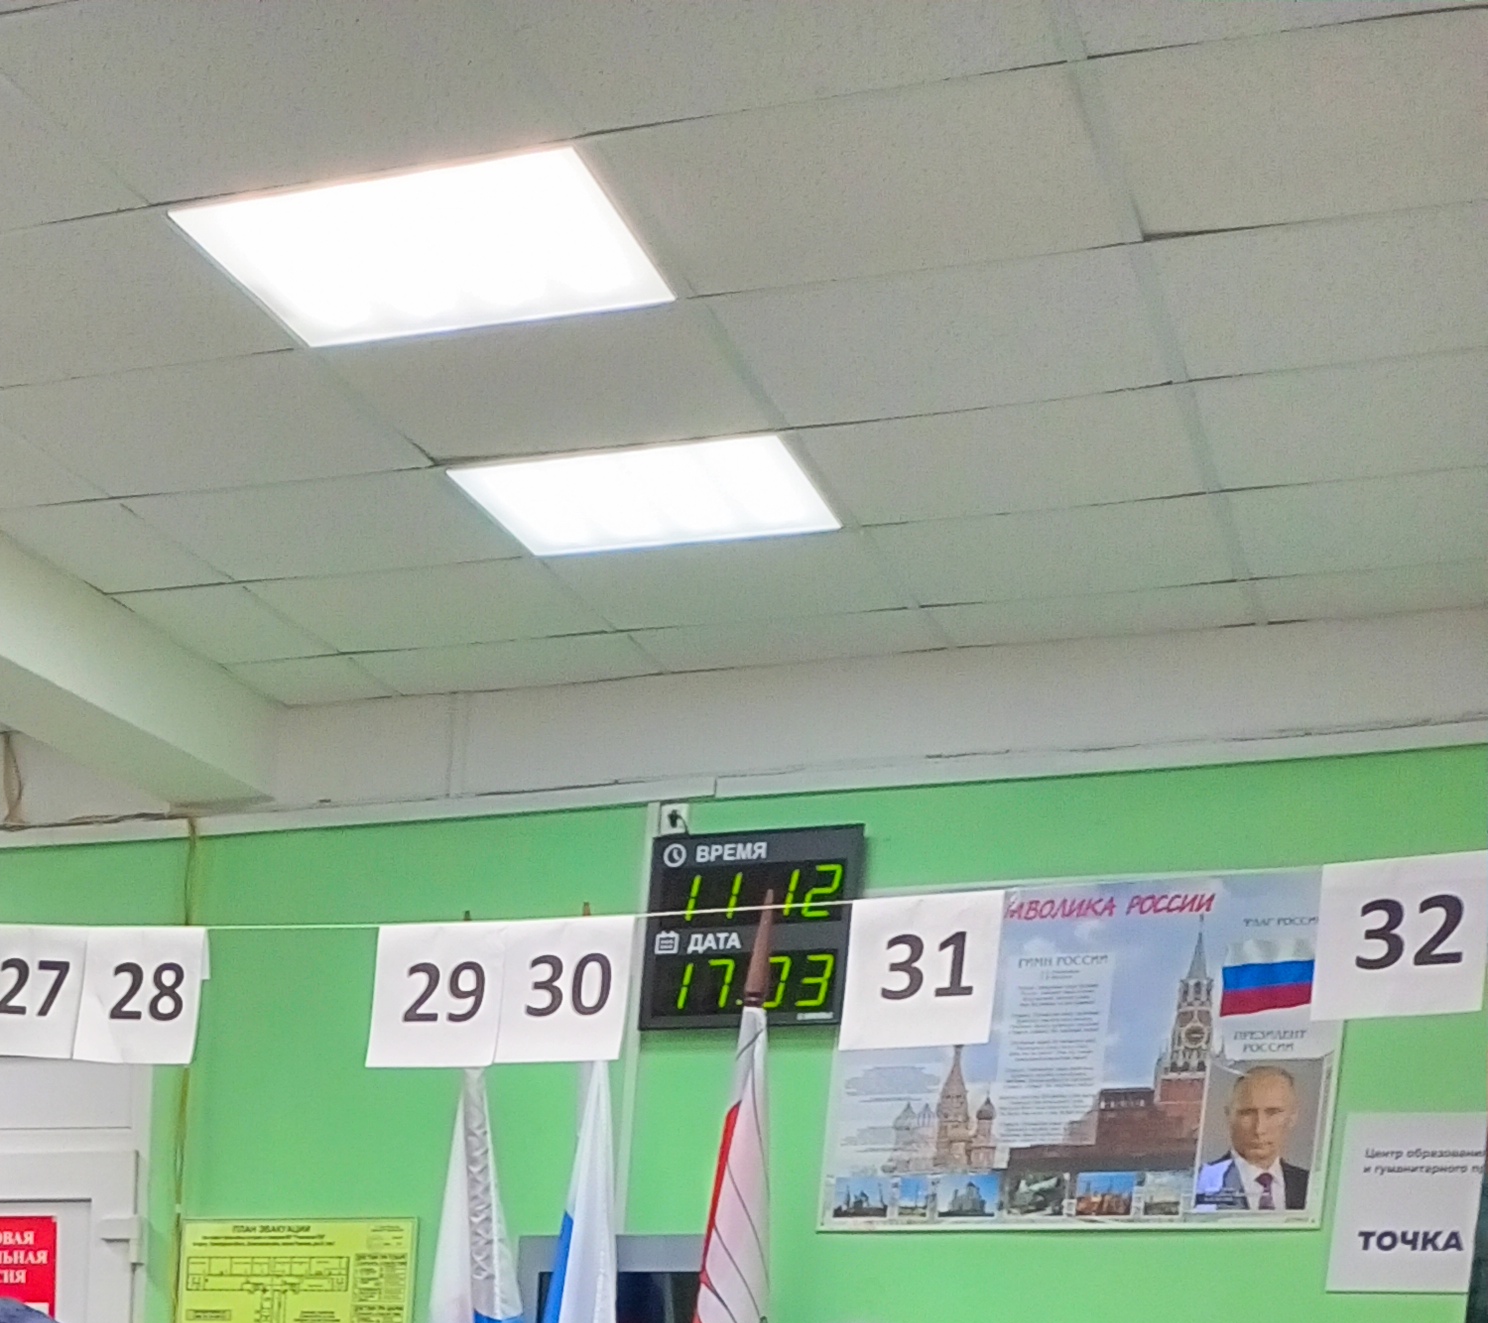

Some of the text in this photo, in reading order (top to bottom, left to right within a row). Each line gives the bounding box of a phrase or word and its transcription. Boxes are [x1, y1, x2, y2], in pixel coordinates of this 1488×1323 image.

[696, 842, 768, 863] ВРЕМЯ
[1125, 893, 1217, 915] РОССИИ
[1277, 916, 1319, 926] РОССИ
[1355, 894, 1464, 970] 32
[686, 932, 742, 954] ДАТА
[880, 930, 973, 1000] 31
[109, 962, 185, 1022] 28
[402, 961, 486, 1023] 29
[525, 952, 612, 1018] 30
[1233, 1029, 1308, 1041] ПРЕЗИДЕНТ
[1243, 1043, 1295, 1053] РОССИИ
[1364, 1149, 1404, 1161] Центр
[1374, 1164, 1468, 1176] гуманитарного
[1358, 1230, 1464, 1252] ТОЧКА
